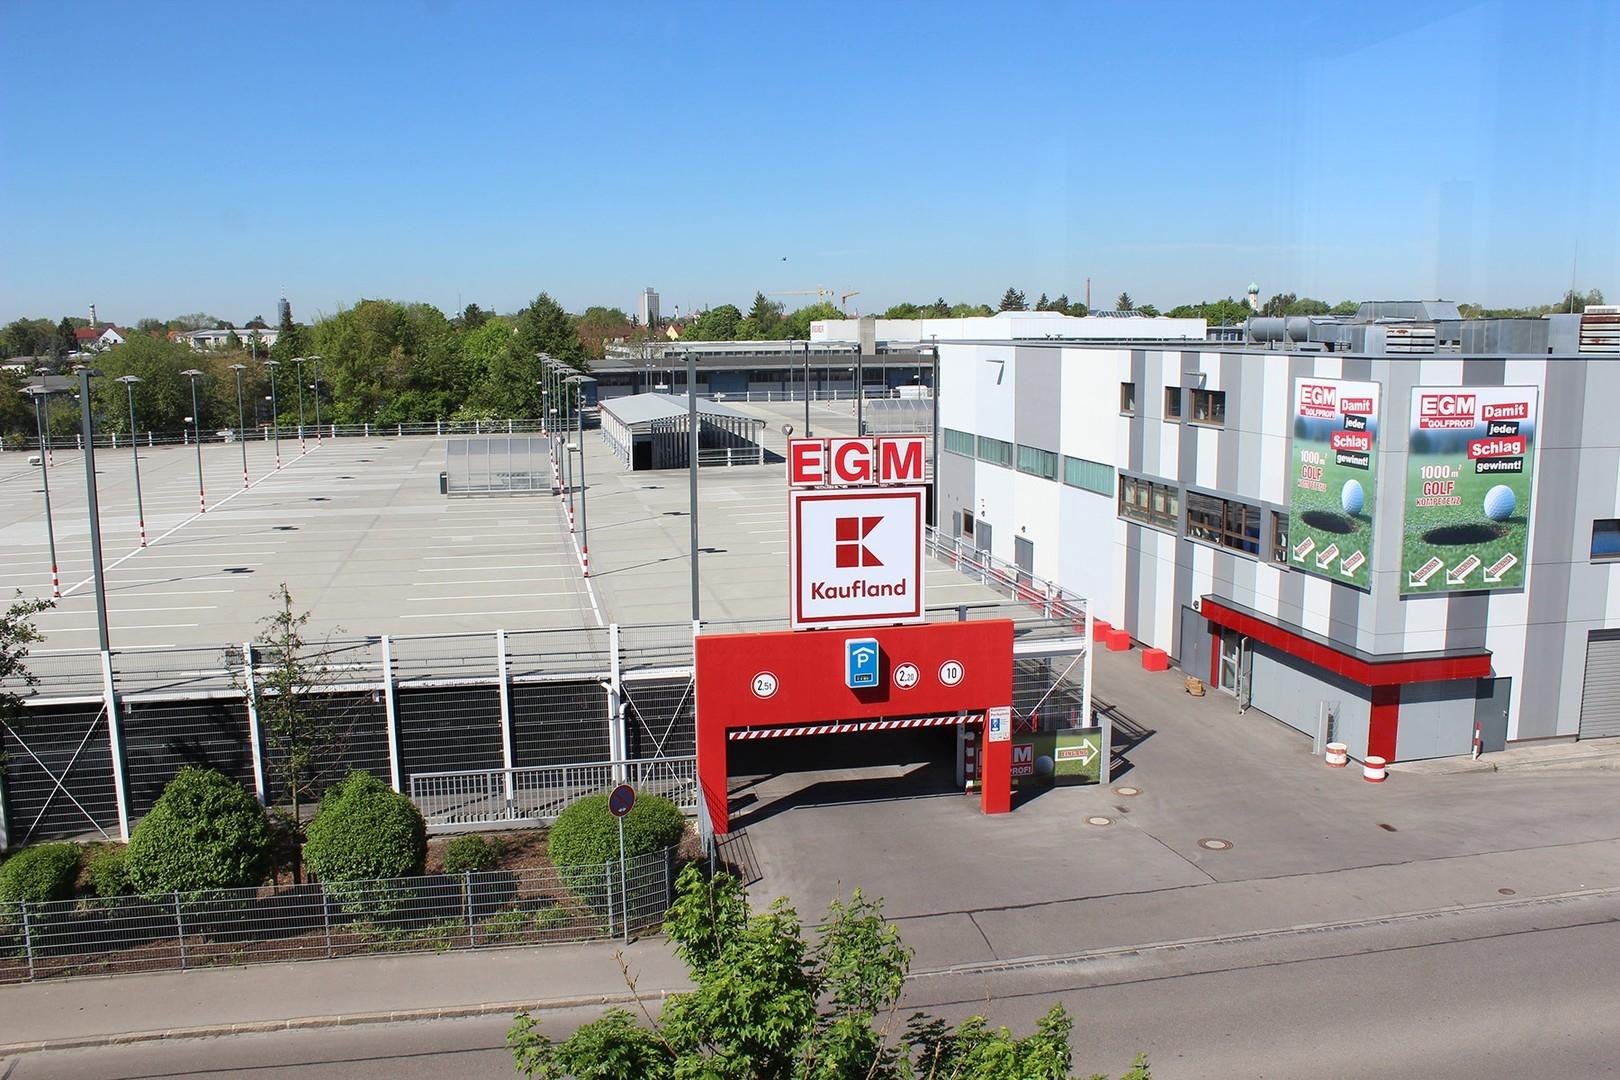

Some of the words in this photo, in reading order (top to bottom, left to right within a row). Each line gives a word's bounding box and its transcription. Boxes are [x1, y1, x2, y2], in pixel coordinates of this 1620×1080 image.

[1301, 386, 1336, 406] EGM
[1342, 400, 1370, 412] Damit
[1422, 396, 1475, 415] EGM
[1485, 404, 1524, 418] Damit
[1345, 418, 1365, 429] jeder
[1428, 419, 1474, 428] GOLFPROFI
[1489, 424, 1517, 435] jeder
[1334, 435, 1368, 450] Schlag
[1472, 441, 1521, 456] Schlag
[793, 442, 922, 482] EGM
[1301, 450, 1319, 464] 1000
[1337, 454, 1368, 466] gewinnt!
[1302, 465, 1323, 481] GOLF
[1421, 465, 1450, 479] 1000
[1476, 461, 1521, 473] gewinnt!
[1423, 481, 1455, 496] GOLF
[811, 578, 906, 600] Kaufland
[858, 654, 869, 668] P
[947, 667, 957, 679] 10
